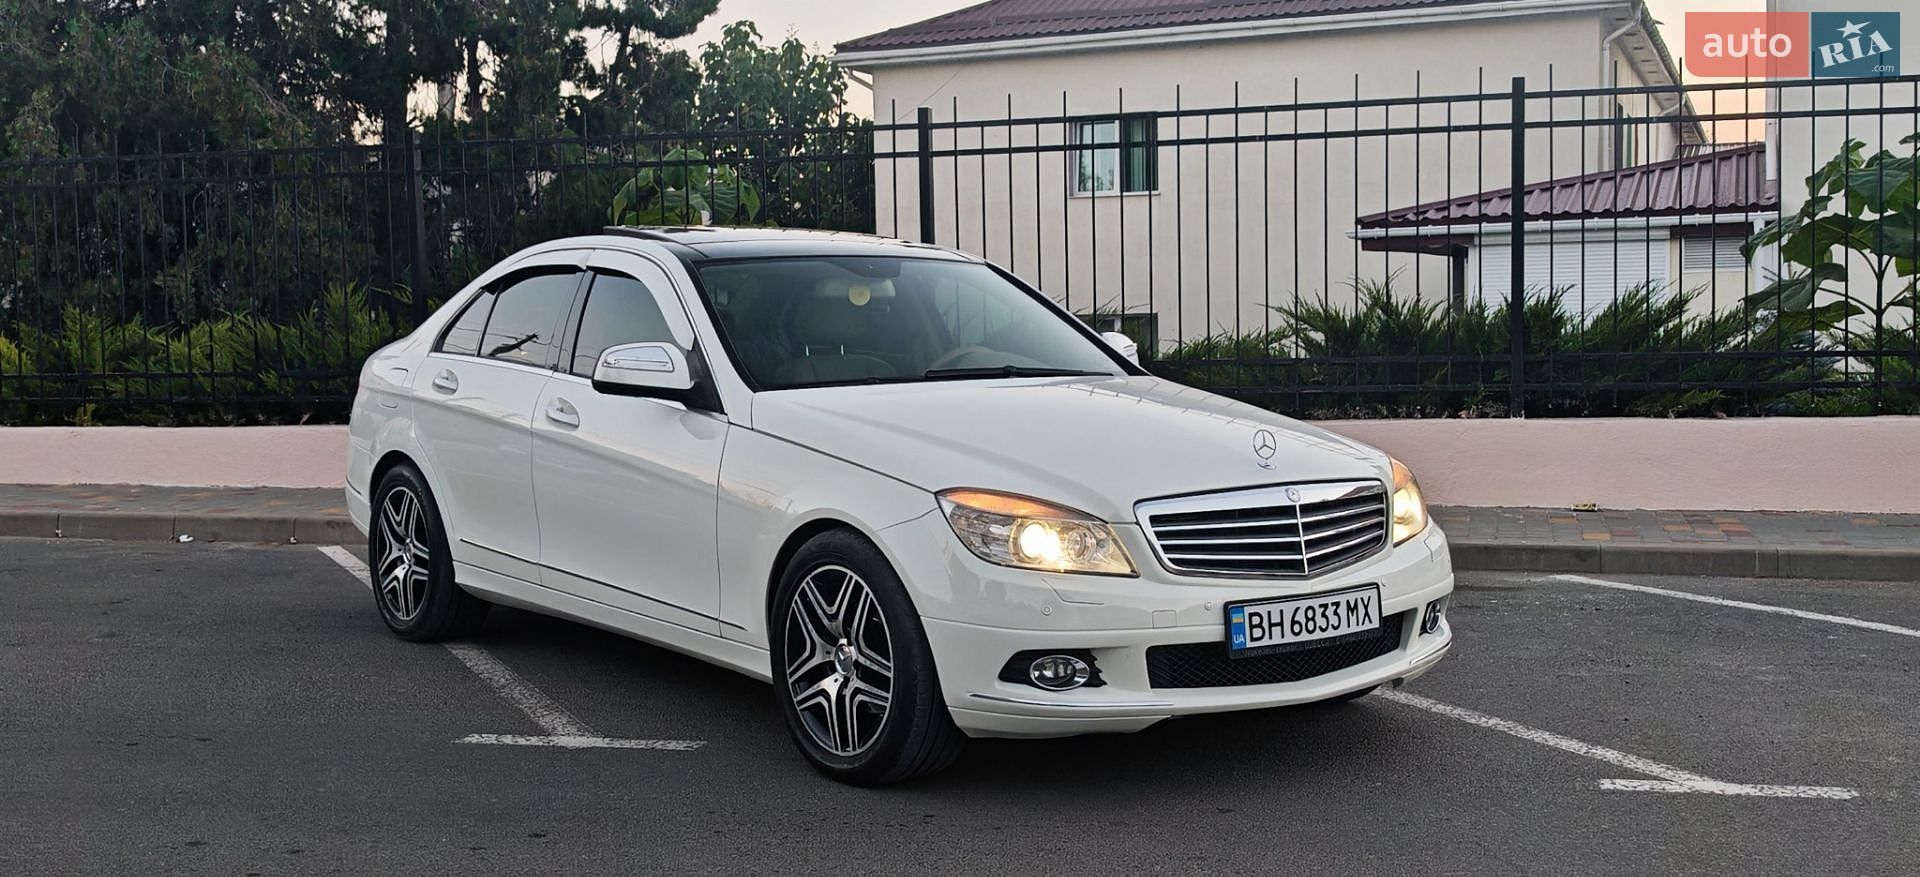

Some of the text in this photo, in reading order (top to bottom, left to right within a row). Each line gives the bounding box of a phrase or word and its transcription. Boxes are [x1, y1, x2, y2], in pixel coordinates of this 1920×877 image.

[1248, 609, 1285, 643] BH
[1290, 601, 1342, 637] 6833
[1346, 595, 1373, 629] MX
[1233, 633, 1246, 644] UA
